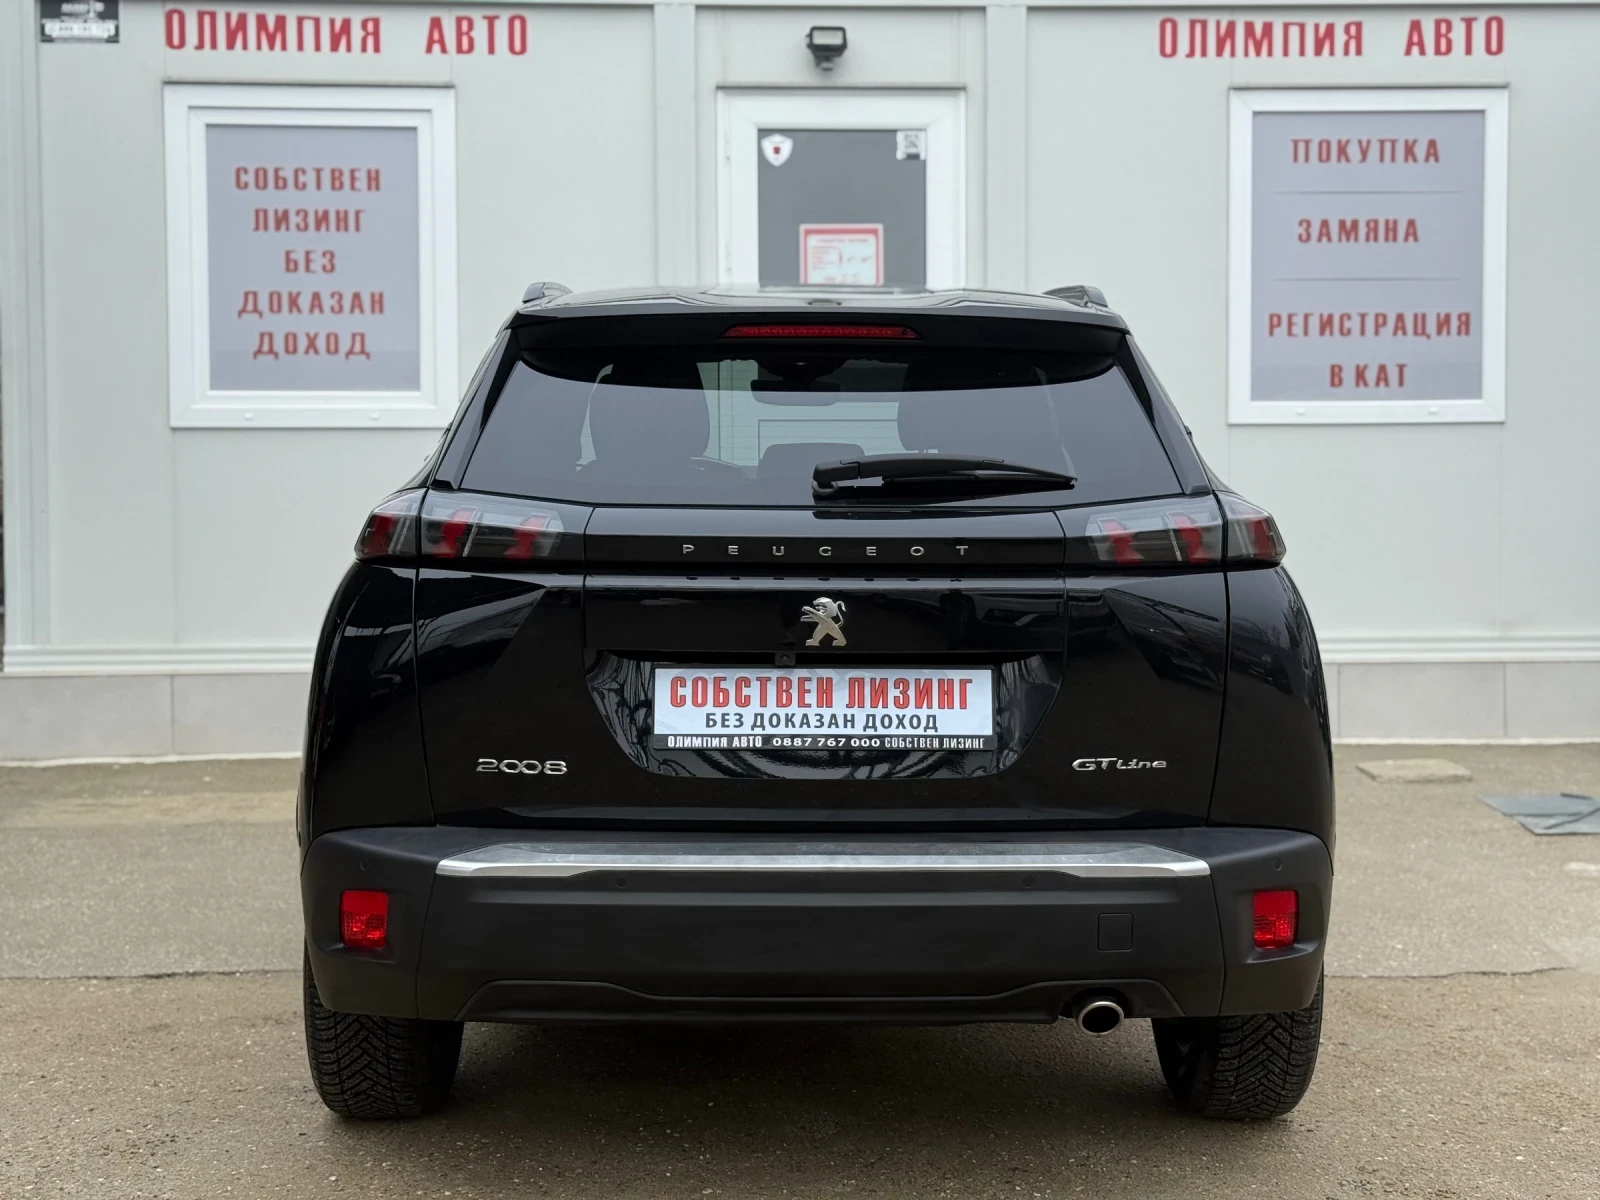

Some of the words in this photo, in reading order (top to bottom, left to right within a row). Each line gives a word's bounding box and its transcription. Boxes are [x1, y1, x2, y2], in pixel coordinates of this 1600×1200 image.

[164, 8, 382, 54] ОЛИМПИЯ
[425, 14, 529, 56] АВТО
[1158, 17, 1364, 59] ОЛИМПИЯ
[1404, 15, 1506, 57] АВТО
[1290, 138, 1441, 164] ПОКУПКА
[234, 166, 382, 192] СОБСТВЕН
[252, 208, 366, 233] ЛИЗИНГ
[1297, 218, 1420, 243] ЗАМЯНА
[284, 249, 337, 274] БЕЗ
[237, 290, 385, 319] ДОКАЗАН
[1267, 311, 1472, 340] РЕГИСТРАЦИЯ
[253, 331, 371, 361] ДОХОД
[1329, 364, 1344, 388] В
[1354, 363, 1409, 388] КАТ
[682, 544, 969, 556] PEUGEOT
[670, 676, 834, 709] СОБСТВЕН
[846, 677, 973, 710] ЛИЗИНГ
[705, 712, 745, 729] БЕЗ
[750, 712, 856, 732] ДОКАЗАН
[862, 713, 939, 733] ДОХОД
[667, 735, 728, 748] ОЛИМПИЯ
[732, 735, 763, 748] АВТО
[772, 737, 812, 747] 0887
[816, 737, 847, 747] 767
[850, 737, 881, 747] 000
[884, 736, 939, 749] СОБСТВЕН
[942, 737, 985, 749] ЛИЗИНГ
[476, 758, 568, 775] 2008
